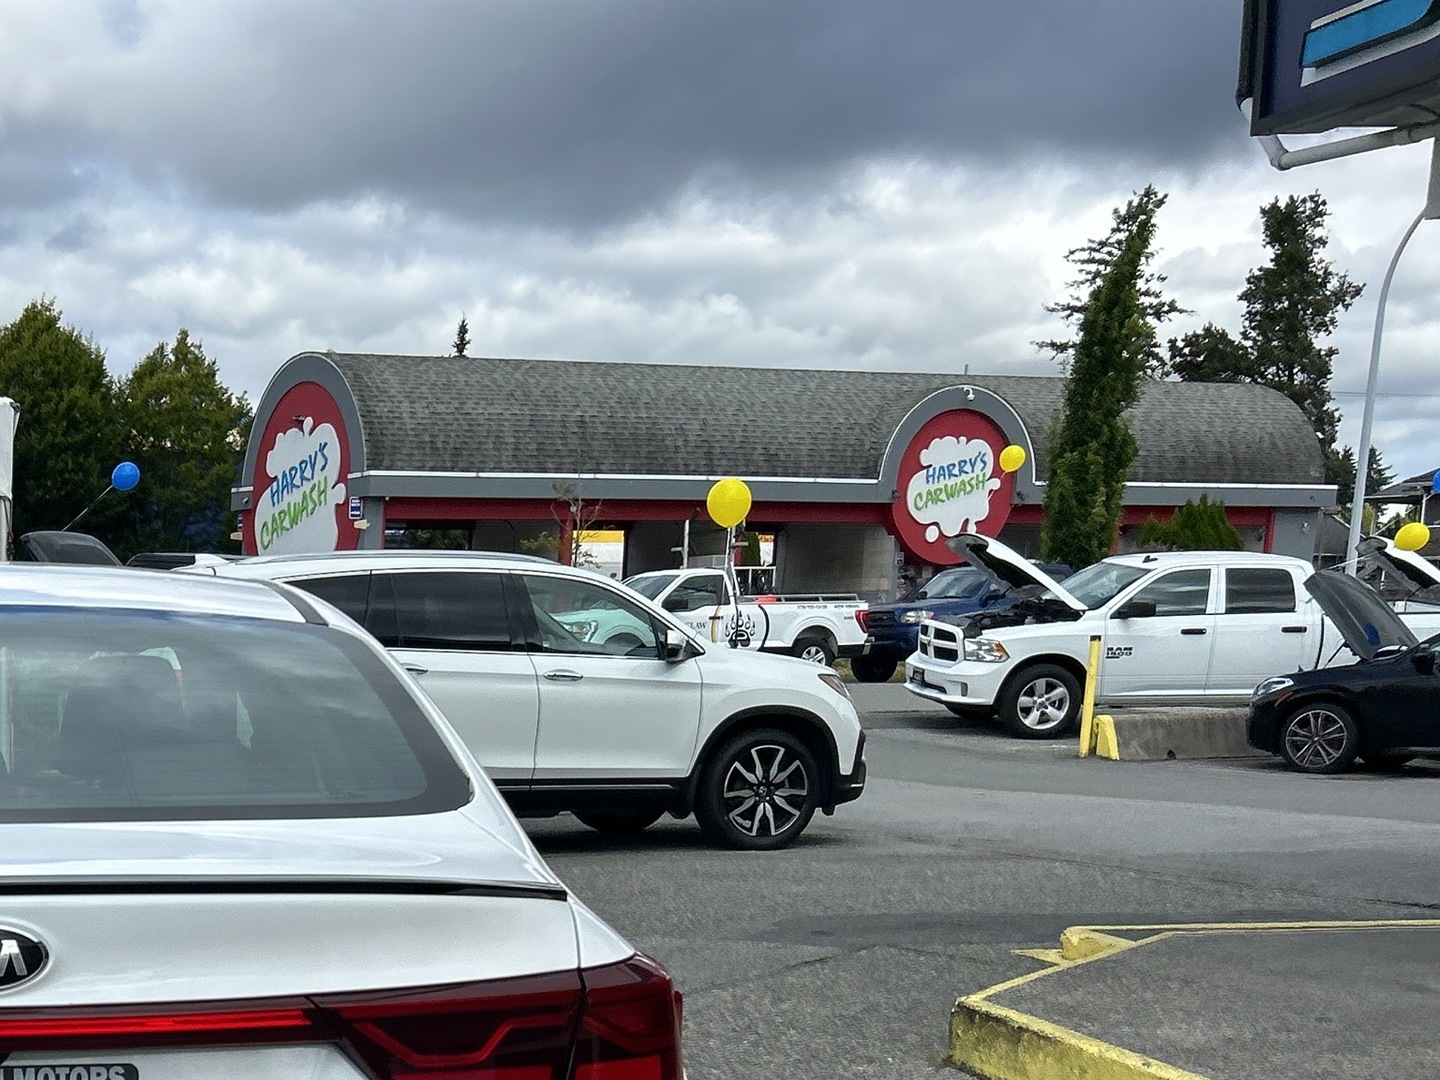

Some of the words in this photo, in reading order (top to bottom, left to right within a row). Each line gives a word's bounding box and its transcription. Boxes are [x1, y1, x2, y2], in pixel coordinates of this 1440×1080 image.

[270, 442, 329, 507] HARRY'S
[913, 472, 987, 511] CARWASH
[925, 451, 987, 485] HARRY'S
[260, 476, 328, 550] CARWASH
